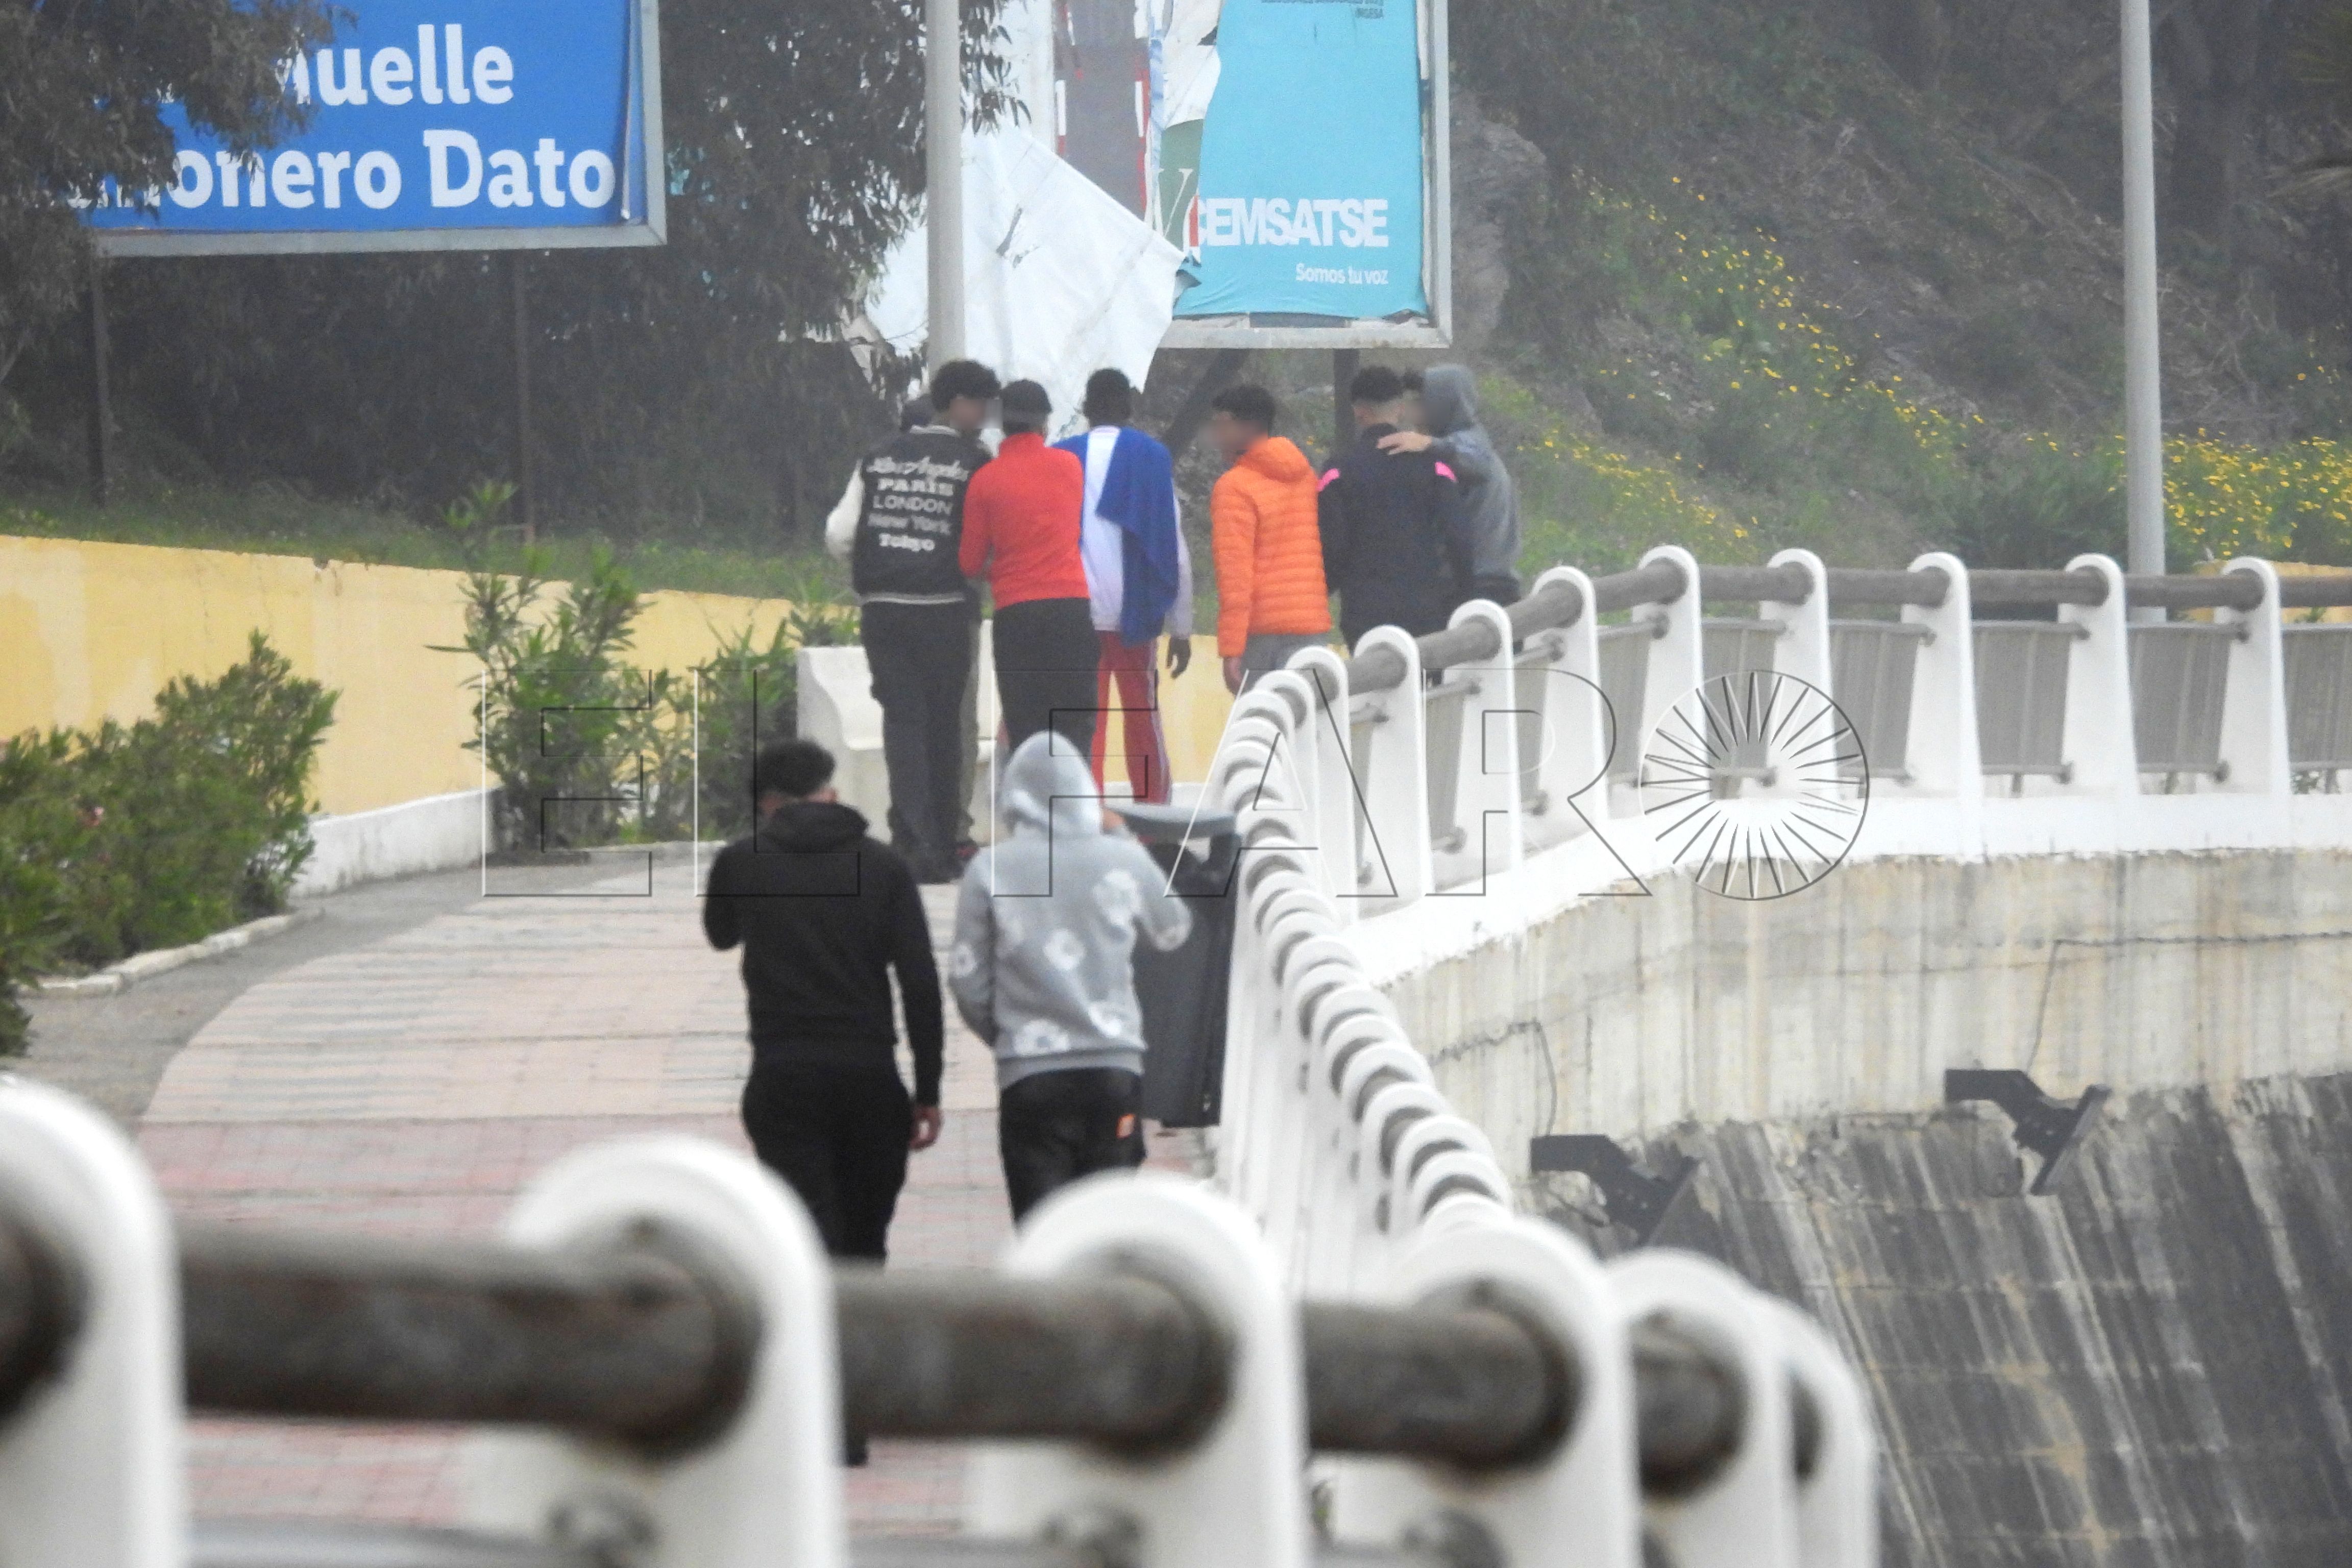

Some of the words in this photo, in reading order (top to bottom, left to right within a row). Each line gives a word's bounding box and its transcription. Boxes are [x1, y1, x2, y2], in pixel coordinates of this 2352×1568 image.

[62, 150, 402, 209] onero
[423, 129, 616, 208] Dato
[1295, 263, 1345, 284] Somos
[1349, 265, 1363, 284] tu
[1364, 269, 1389, 285] voz
[873, 495, 953, 516] LONDON
